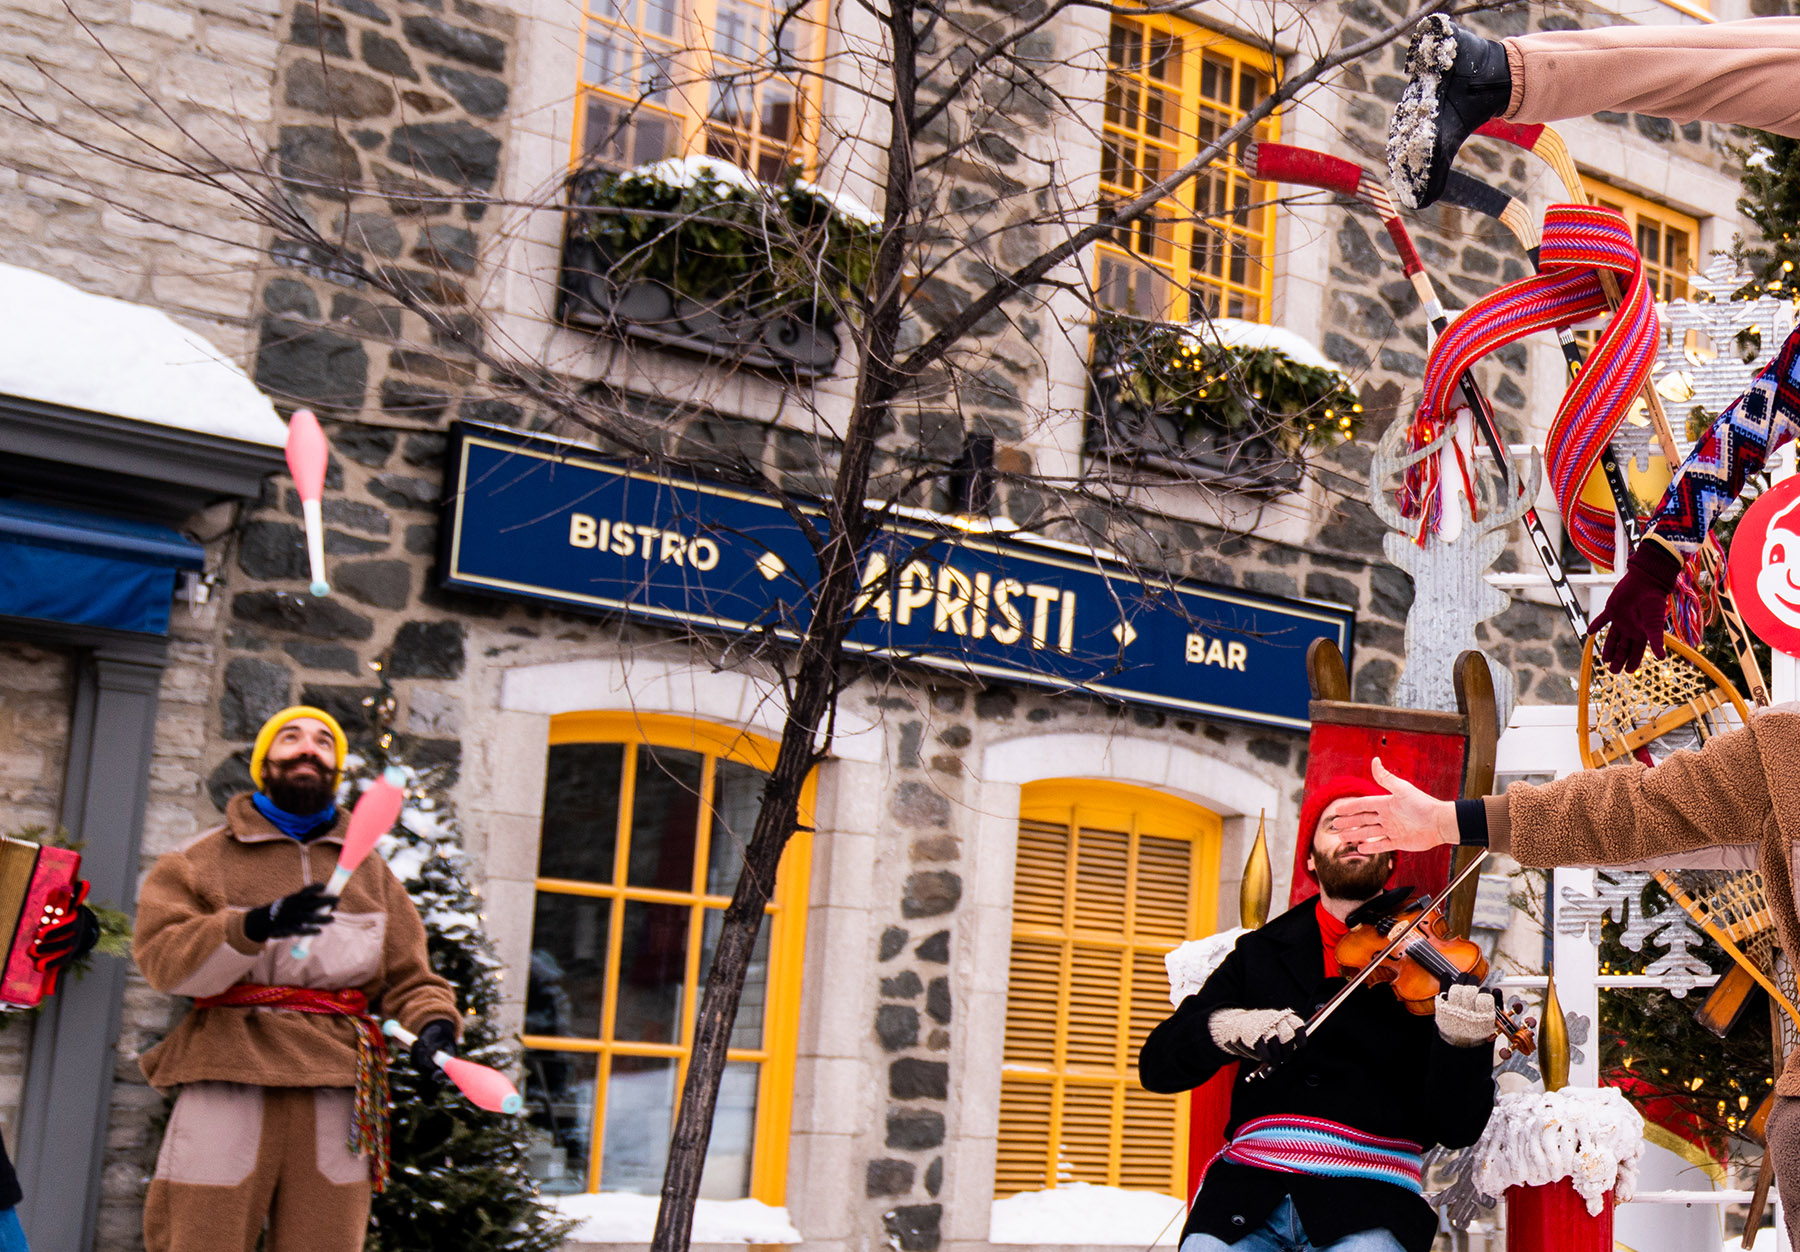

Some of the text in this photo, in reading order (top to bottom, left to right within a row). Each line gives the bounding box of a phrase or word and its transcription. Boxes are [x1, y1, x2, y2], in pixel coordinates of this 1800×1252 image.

[569, 513, 1248, 672] BISTRO APRISTI BAR
